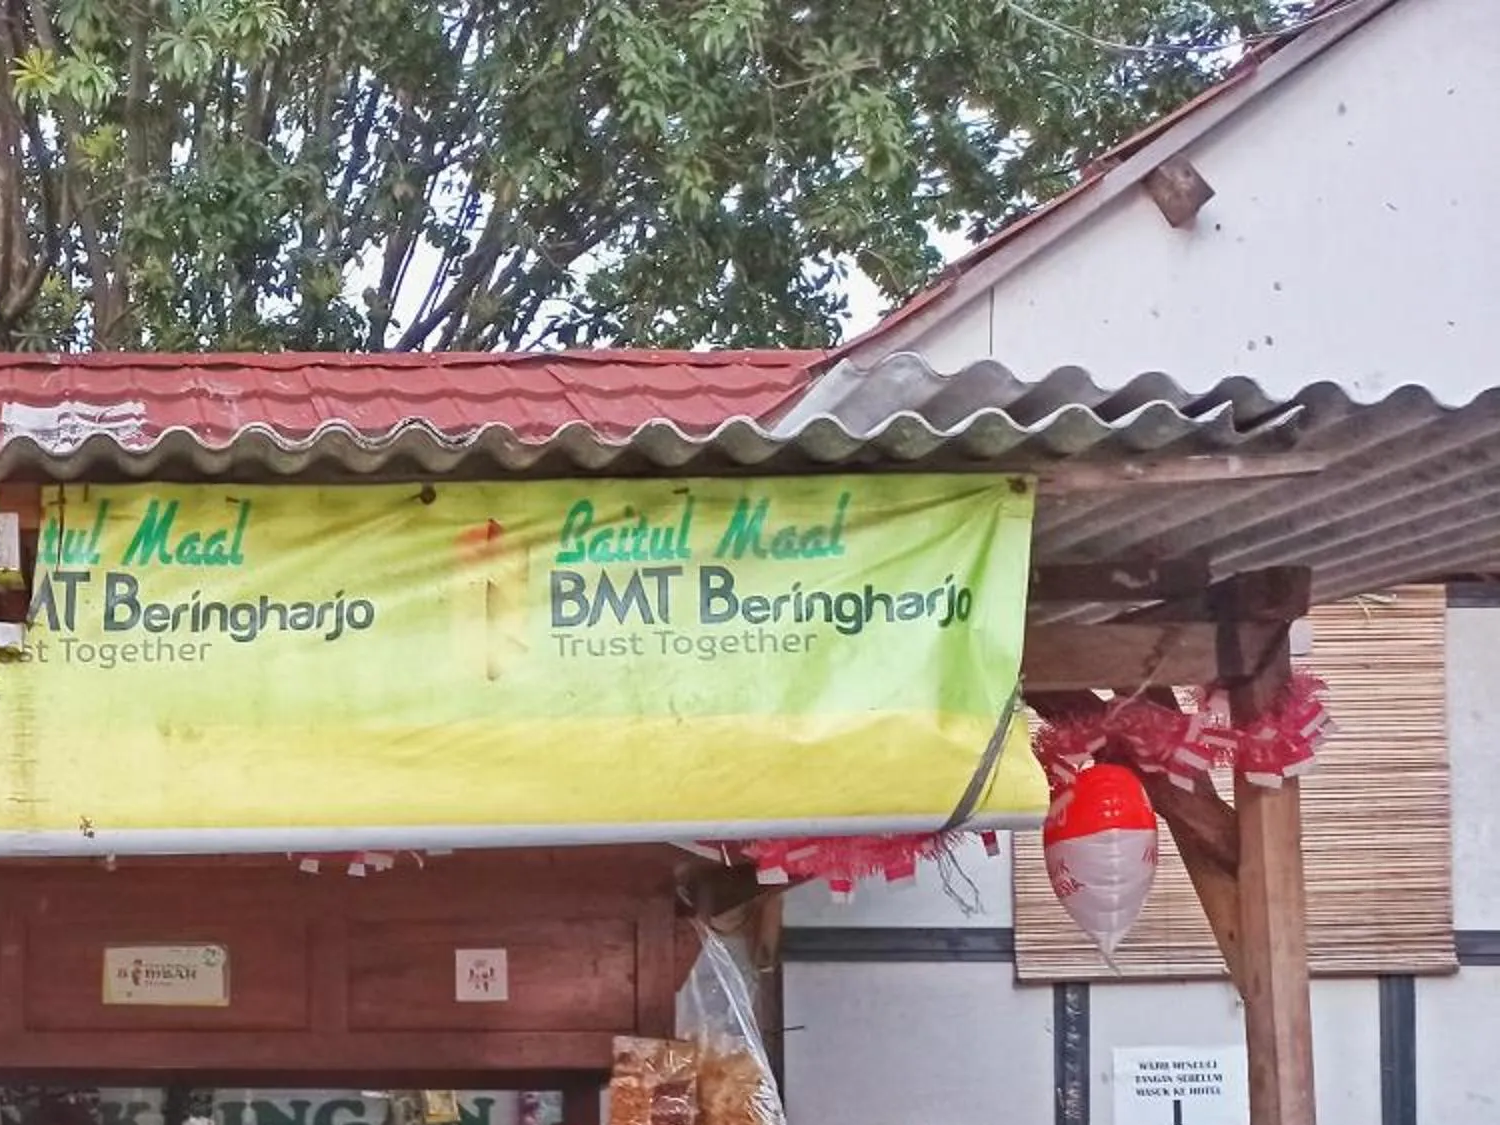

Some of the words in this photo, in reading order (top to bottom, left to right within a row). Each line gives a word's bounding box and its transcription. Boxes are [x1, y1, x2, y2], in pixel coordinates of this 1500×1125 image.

[122, 499, 251, 567] Maal
[556, 495, 694, 563] Baitul
[714, 492, 850, 560] Maal
[103, 571, 375, 643] Beringharjo
[550, 566, 683, 628] BMT
[699, 565, 972, 635] Beringharjo
[58, 637, 212, 669] Together
[552, 631, 644, 658] Trust
[652, 629, 818, 661] Together
